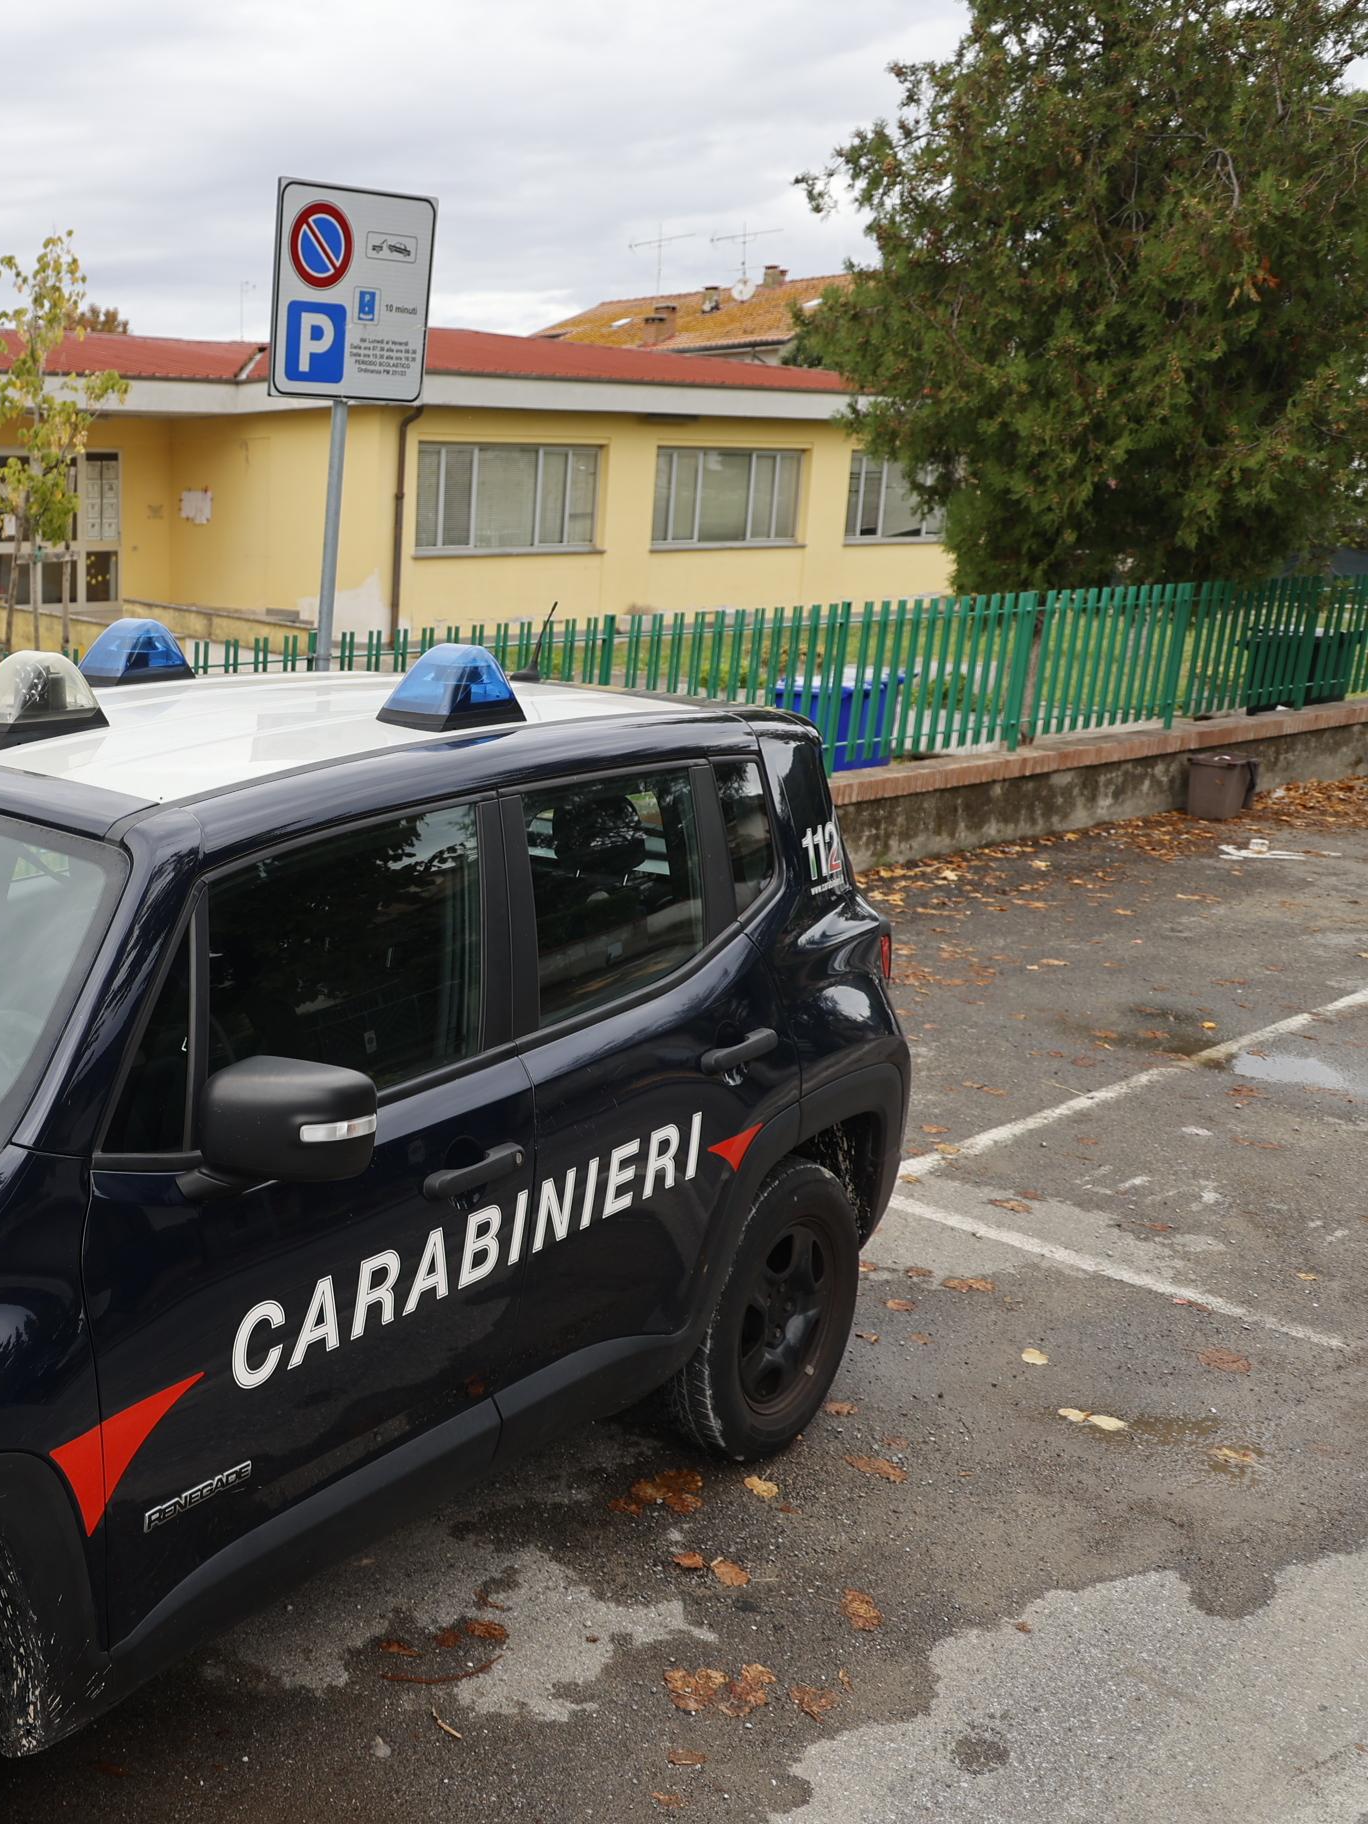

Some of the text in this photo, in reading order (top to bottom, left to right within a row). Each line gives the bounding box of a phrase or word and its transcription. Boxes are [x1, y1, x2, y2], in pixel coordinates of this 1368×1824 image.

[384, 304, 418, 315] 10 minuti
[298, 312, 335, 372] P
[378, 361, 411, 369] SCOLASTICO
[801, 821, 842, 881] 112
[231, 1111, 703, 1390] CARABINIERI
[143, 1459, 252, 1534] RENEGADE
